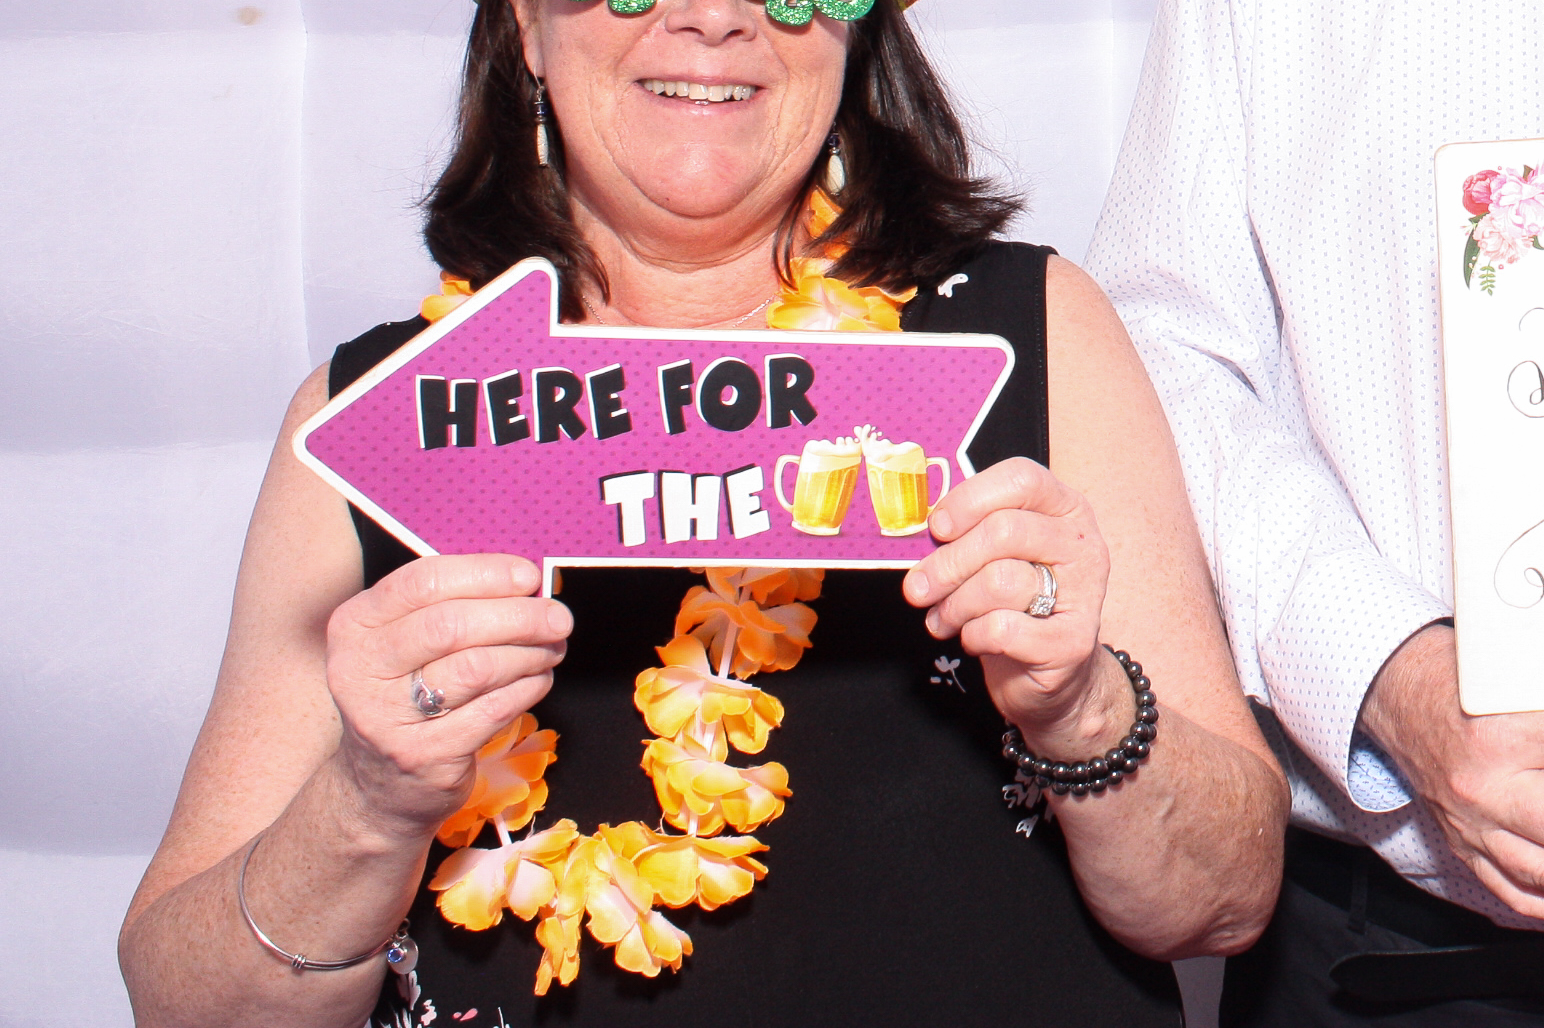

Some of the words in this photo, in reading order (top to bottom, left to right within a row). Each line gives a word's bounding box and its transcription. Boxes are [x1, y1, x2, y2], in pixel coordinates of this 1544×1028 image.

[415, 363, 631, 451] HERE
[658, 354, 819, 435] FOR
[599, 464, 771, 548] THE
